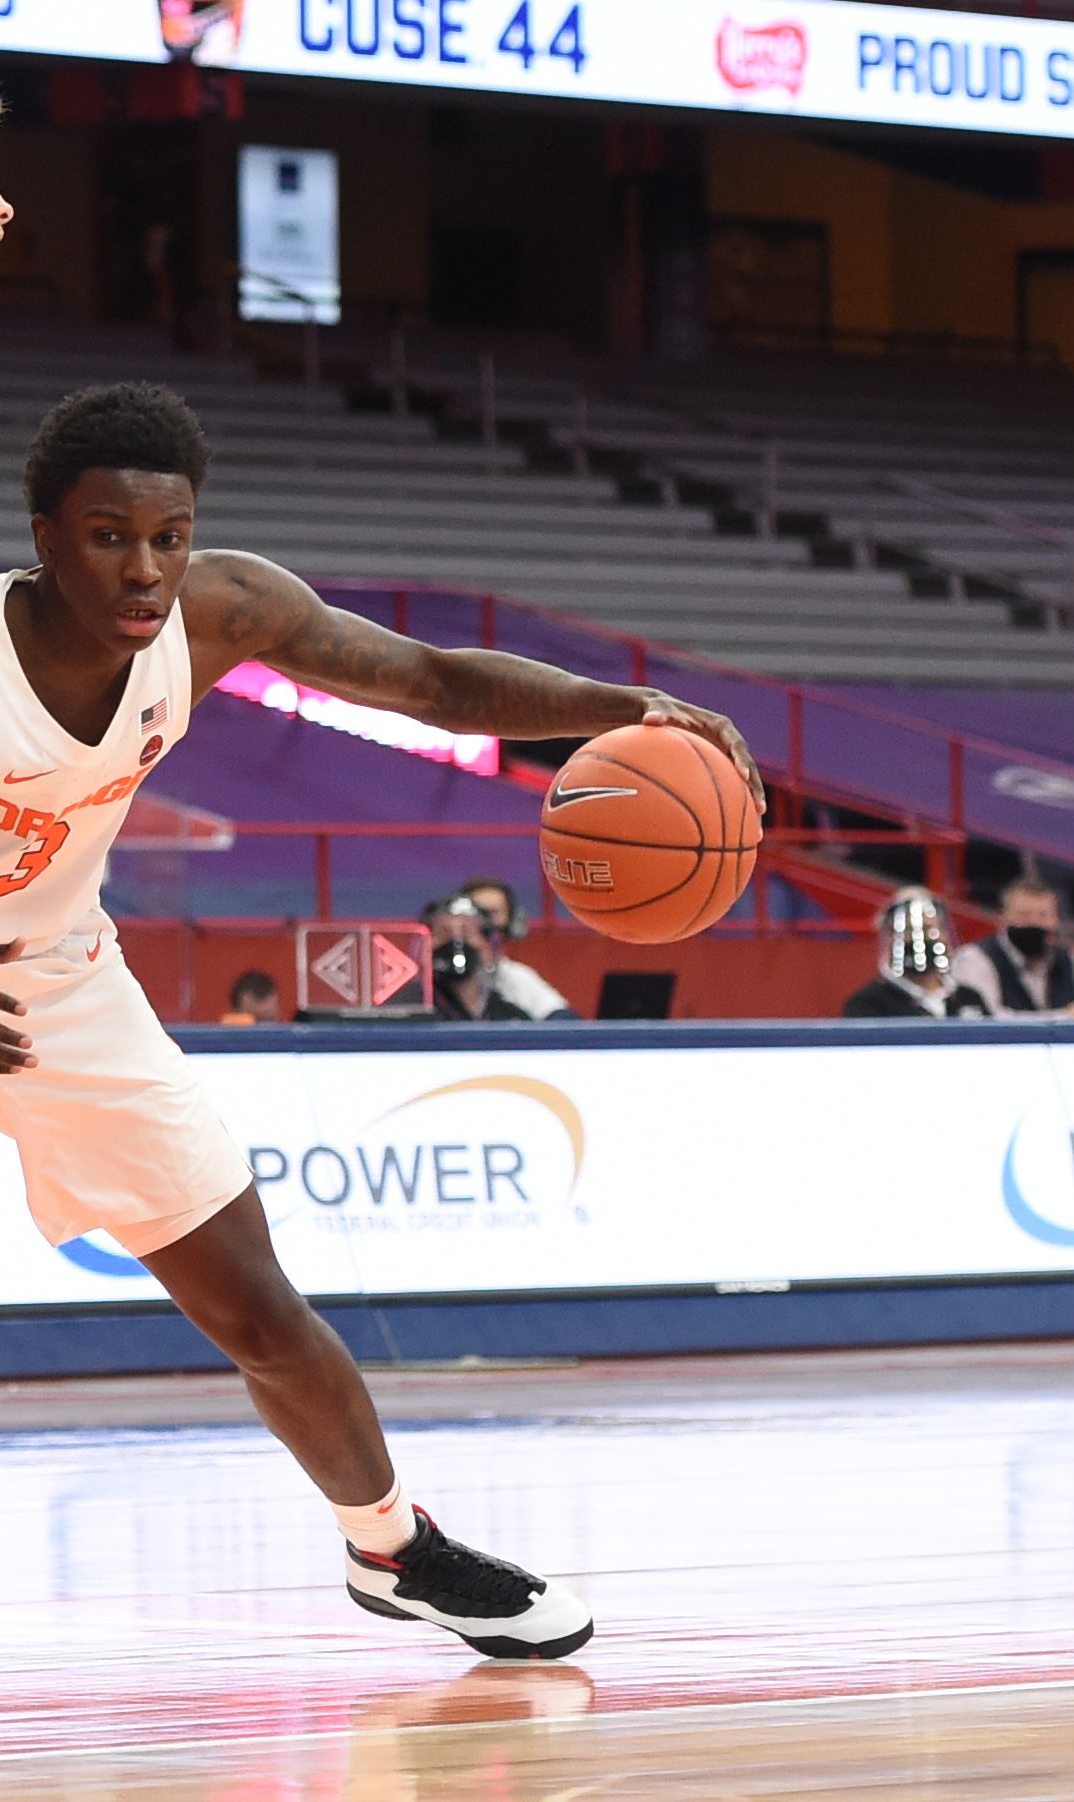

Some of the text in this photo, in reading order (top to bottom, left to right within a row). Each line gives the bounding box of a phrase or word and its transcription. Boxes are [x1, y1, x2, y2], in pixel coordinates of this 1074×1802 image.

[299, 0, 587, 73] CUSE 44
[858, 34, 1025, 102] PROUD
[248, 1144, 529, 1206] POWER
